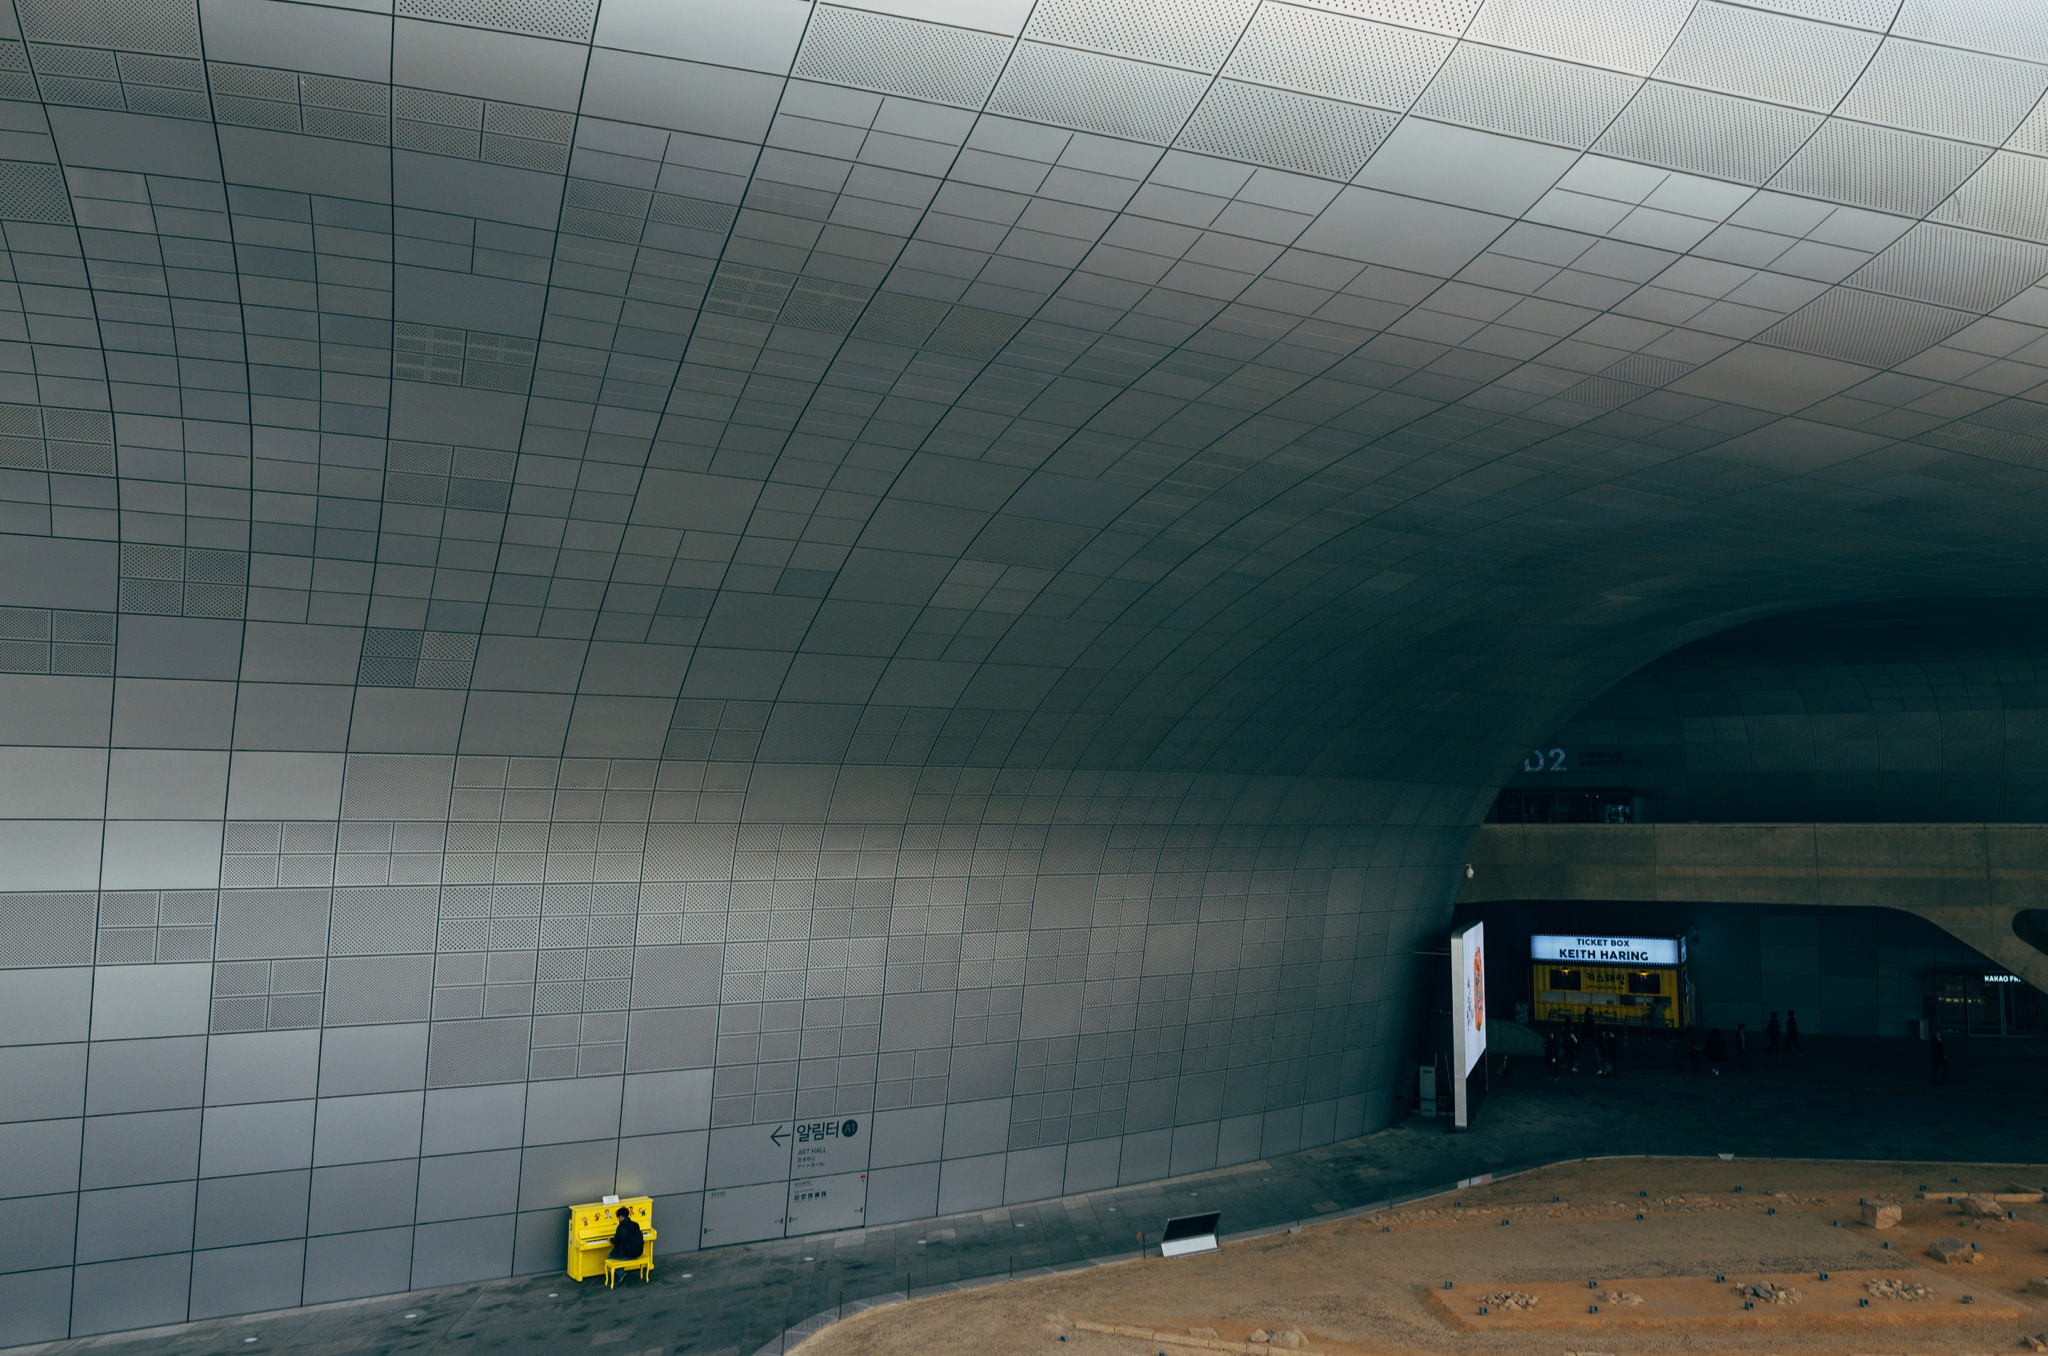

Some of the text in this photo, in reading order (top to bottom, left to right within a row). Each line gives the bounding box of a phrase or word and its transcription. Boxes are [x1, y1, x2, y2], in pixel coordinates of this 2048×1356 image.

[1577, 938, 1630, 947] TICKET BOX
[1559, 949, 1649, 961] KEITH HARING
[1984, 975, 2009, 983] KAKAO
[797, 1120, 839, 1142] 알림터
[798, 1146, 827, 1156] ART HALL
